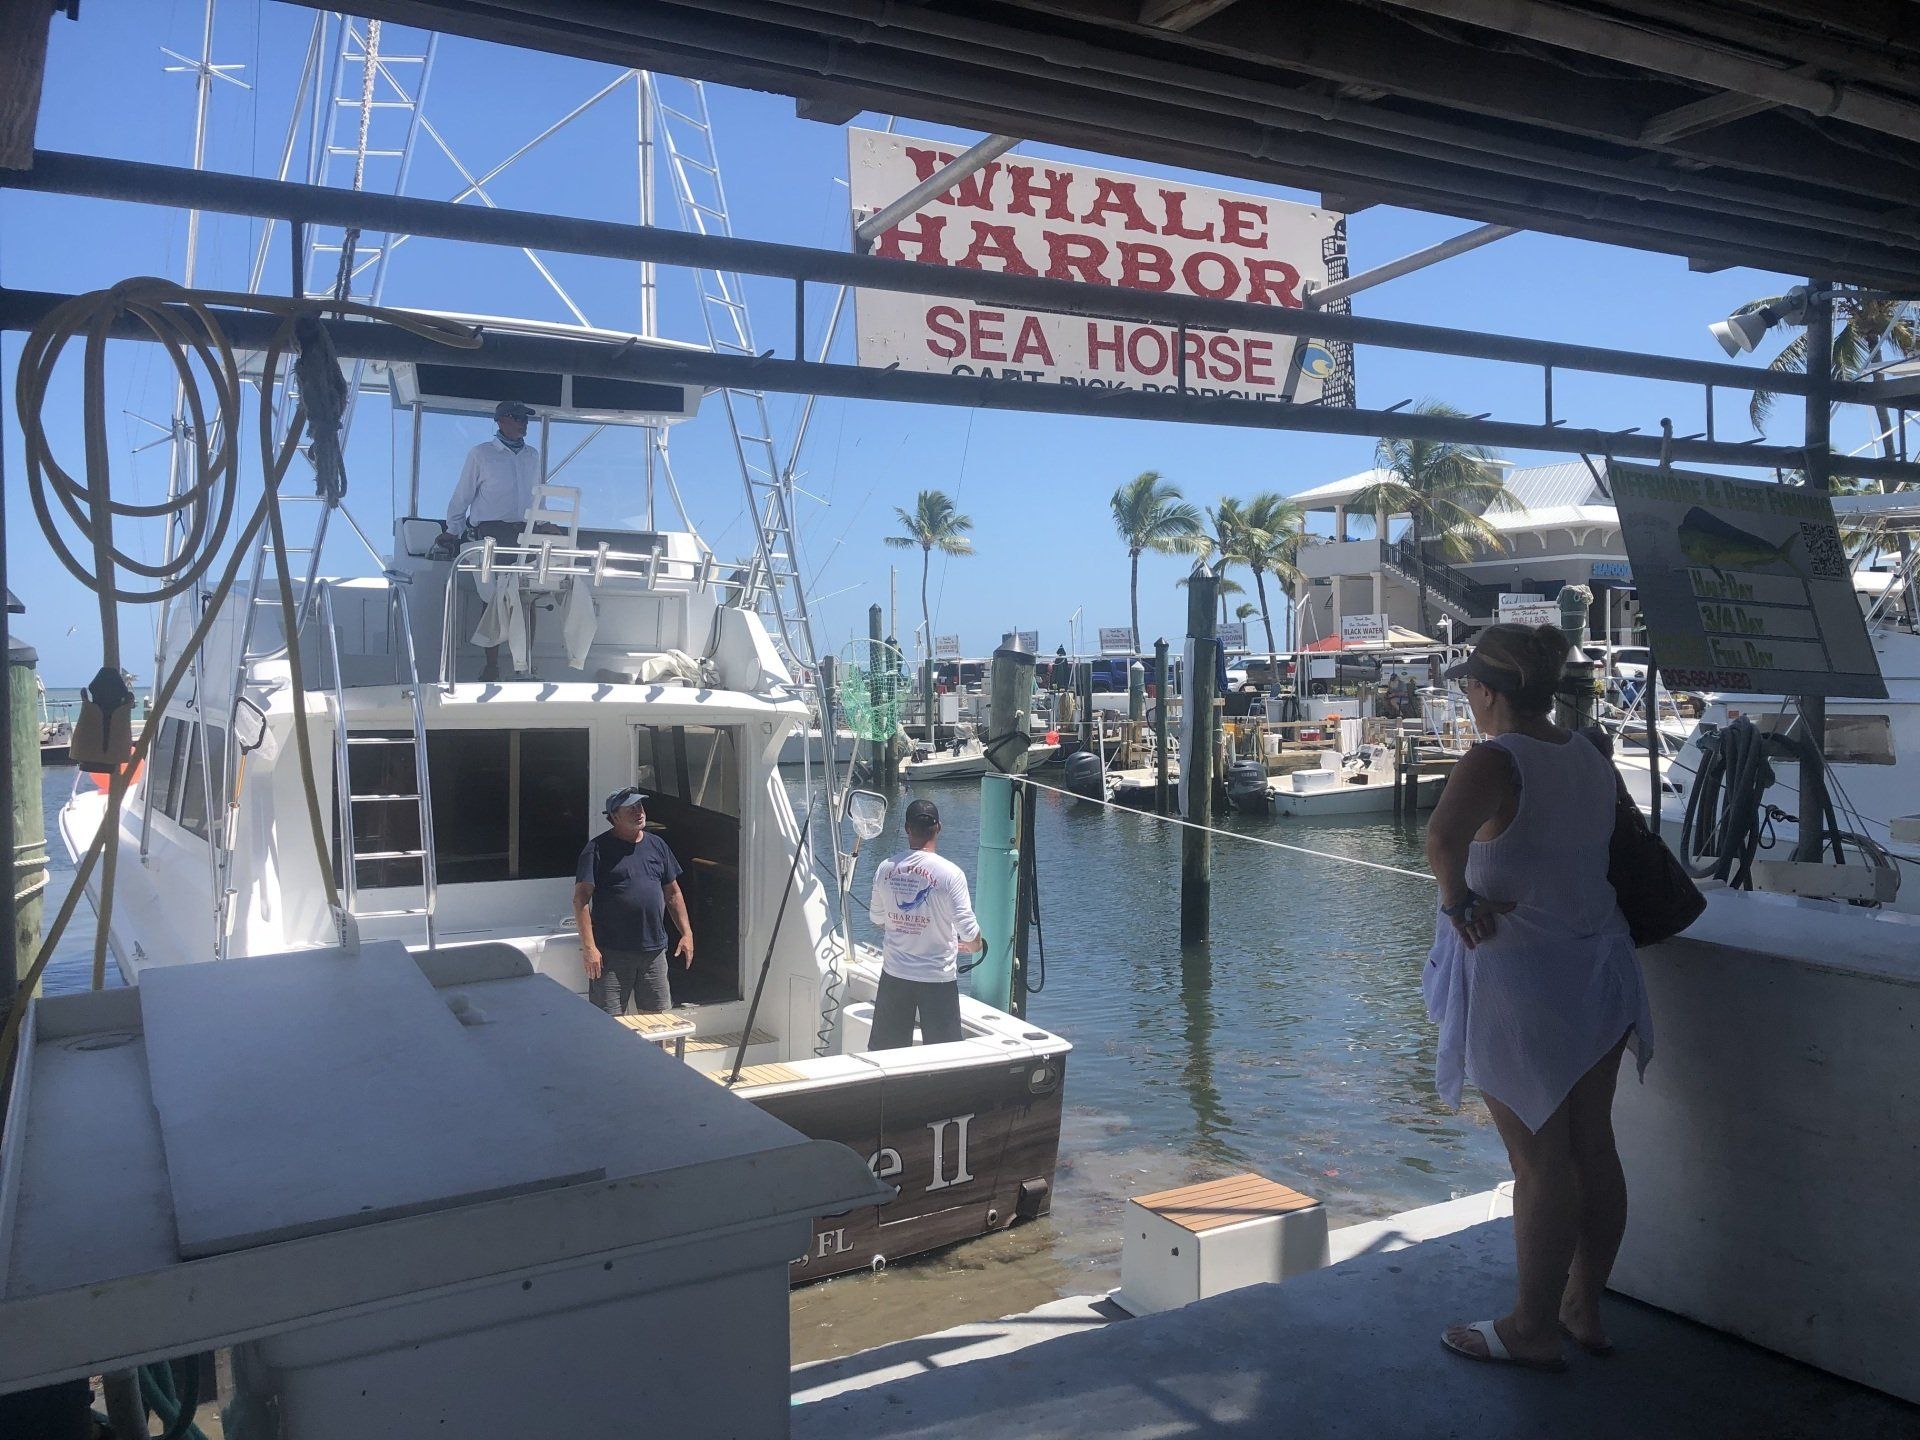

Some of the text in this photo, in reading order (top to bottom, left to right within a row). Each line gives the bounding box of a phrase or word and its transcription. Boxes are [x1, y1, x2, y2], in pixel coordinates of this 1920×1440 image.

[905, 146, 1268, 249] WHALE
[873, 208, 1303, 308] HARBOR
[926, 305, 1275, 386] SEA HORSE
[1362, 627, 1383, 635] WATER
[817, 1227, 855, 1259] FL
